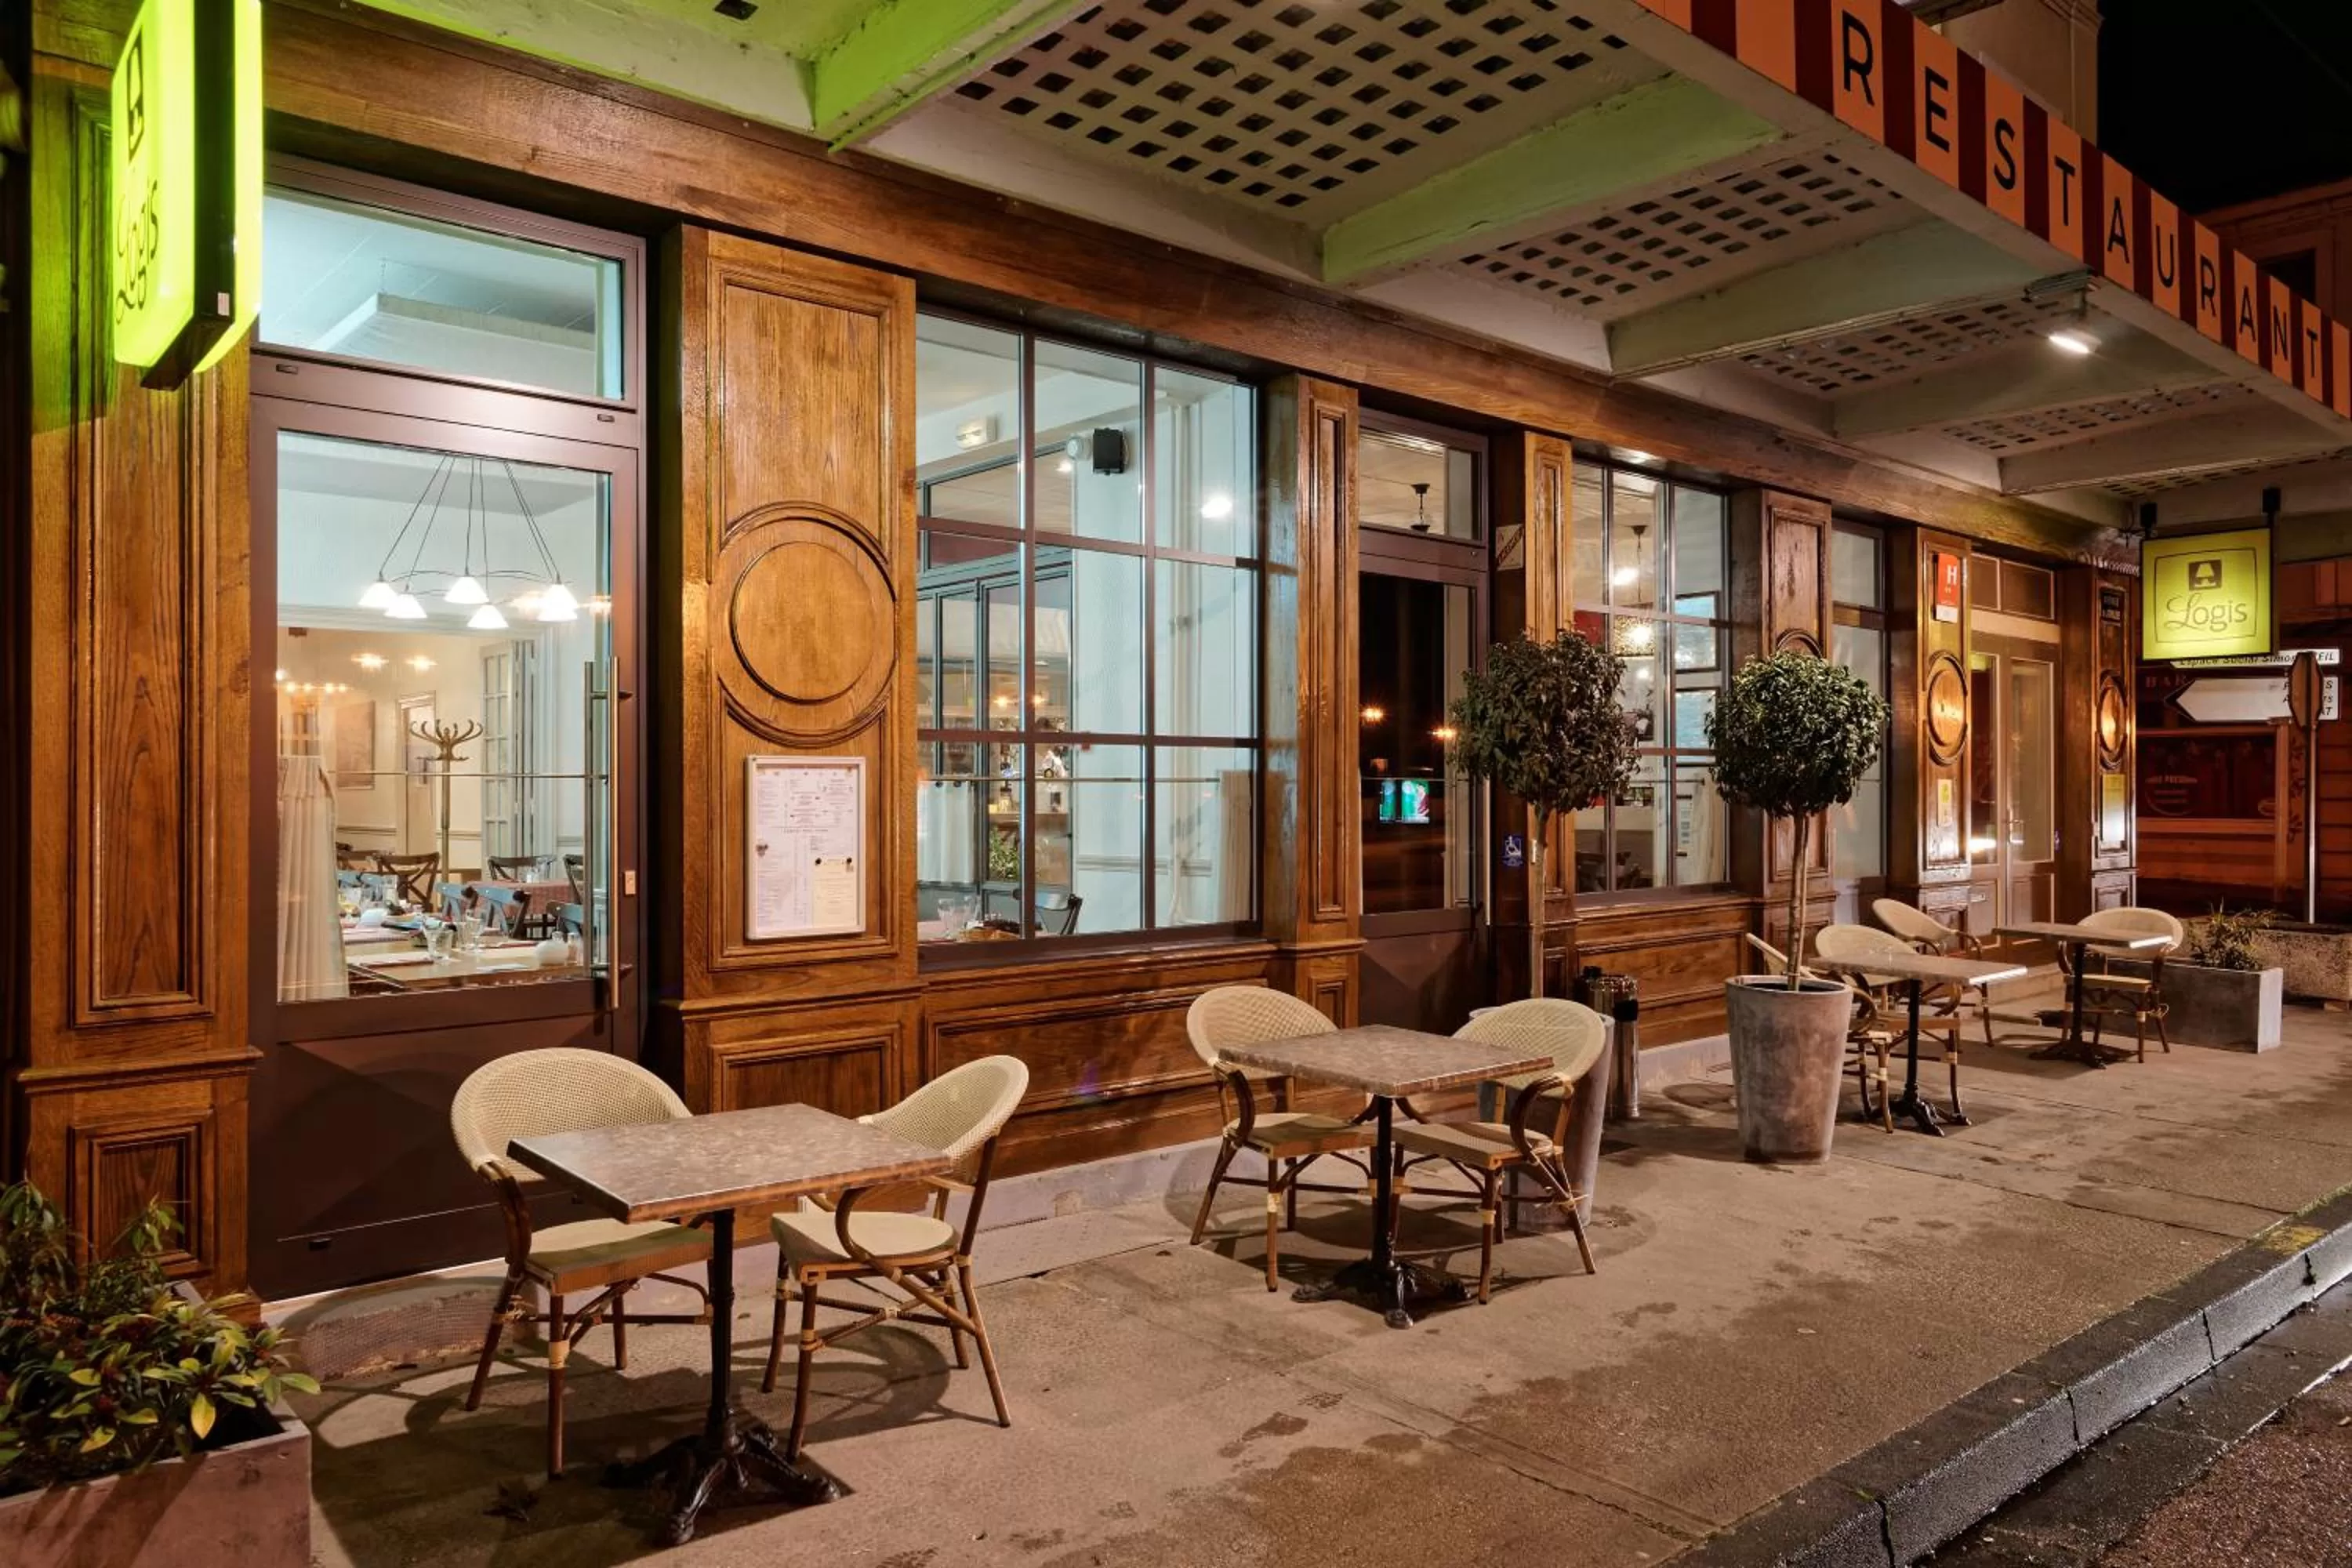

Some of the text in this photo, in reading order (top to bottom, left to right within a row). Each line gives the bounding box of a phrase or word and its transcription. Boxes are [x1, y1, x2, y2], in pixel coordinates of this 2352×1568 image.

[1841, 9, 2318, 379] RESTAURANT
[1947, 564, 1958, 586] H
[2164, 592, 2248, 632] Logis
[2318, 652, 2335, 661] EIL
